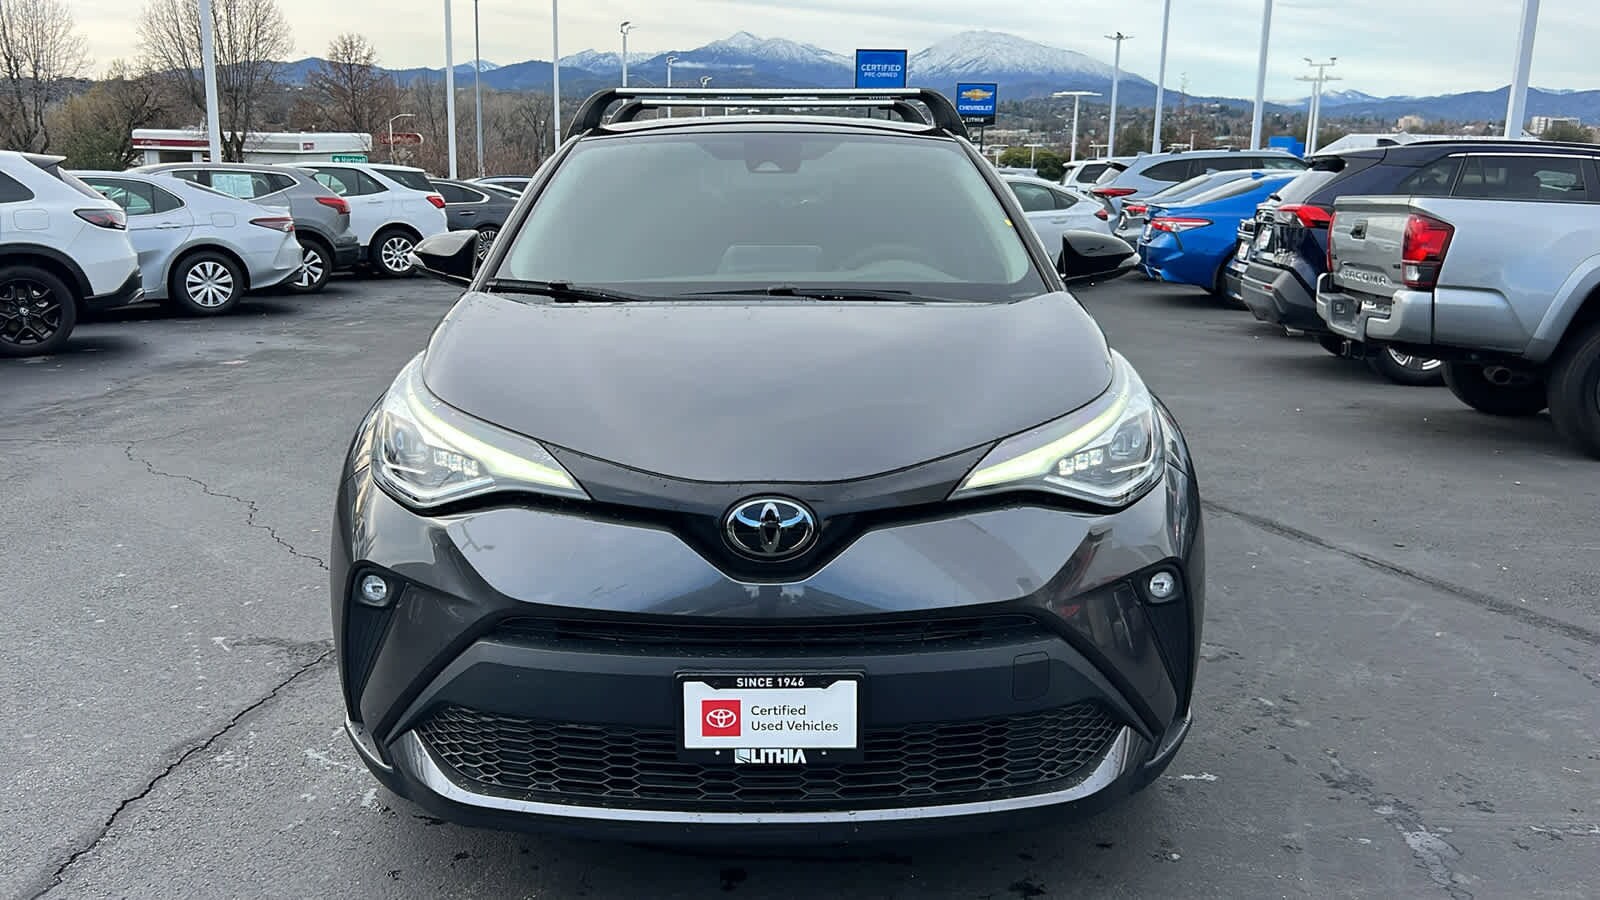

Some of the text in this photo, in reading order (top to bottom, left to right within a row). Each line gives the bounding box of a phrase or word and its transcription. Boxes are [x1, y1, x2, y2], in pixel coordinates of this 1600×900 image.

[861, 64, 902, 72] CERTIFIED
[1343, 269, 1387, 285] TACOMA
[736, 677, 805, 688] SINCE 1946
[751, 705, 807, 716] Certified
[751, 720, 839, 731] Used Vehicles
[750, 748, 807, 764] LITHIA
